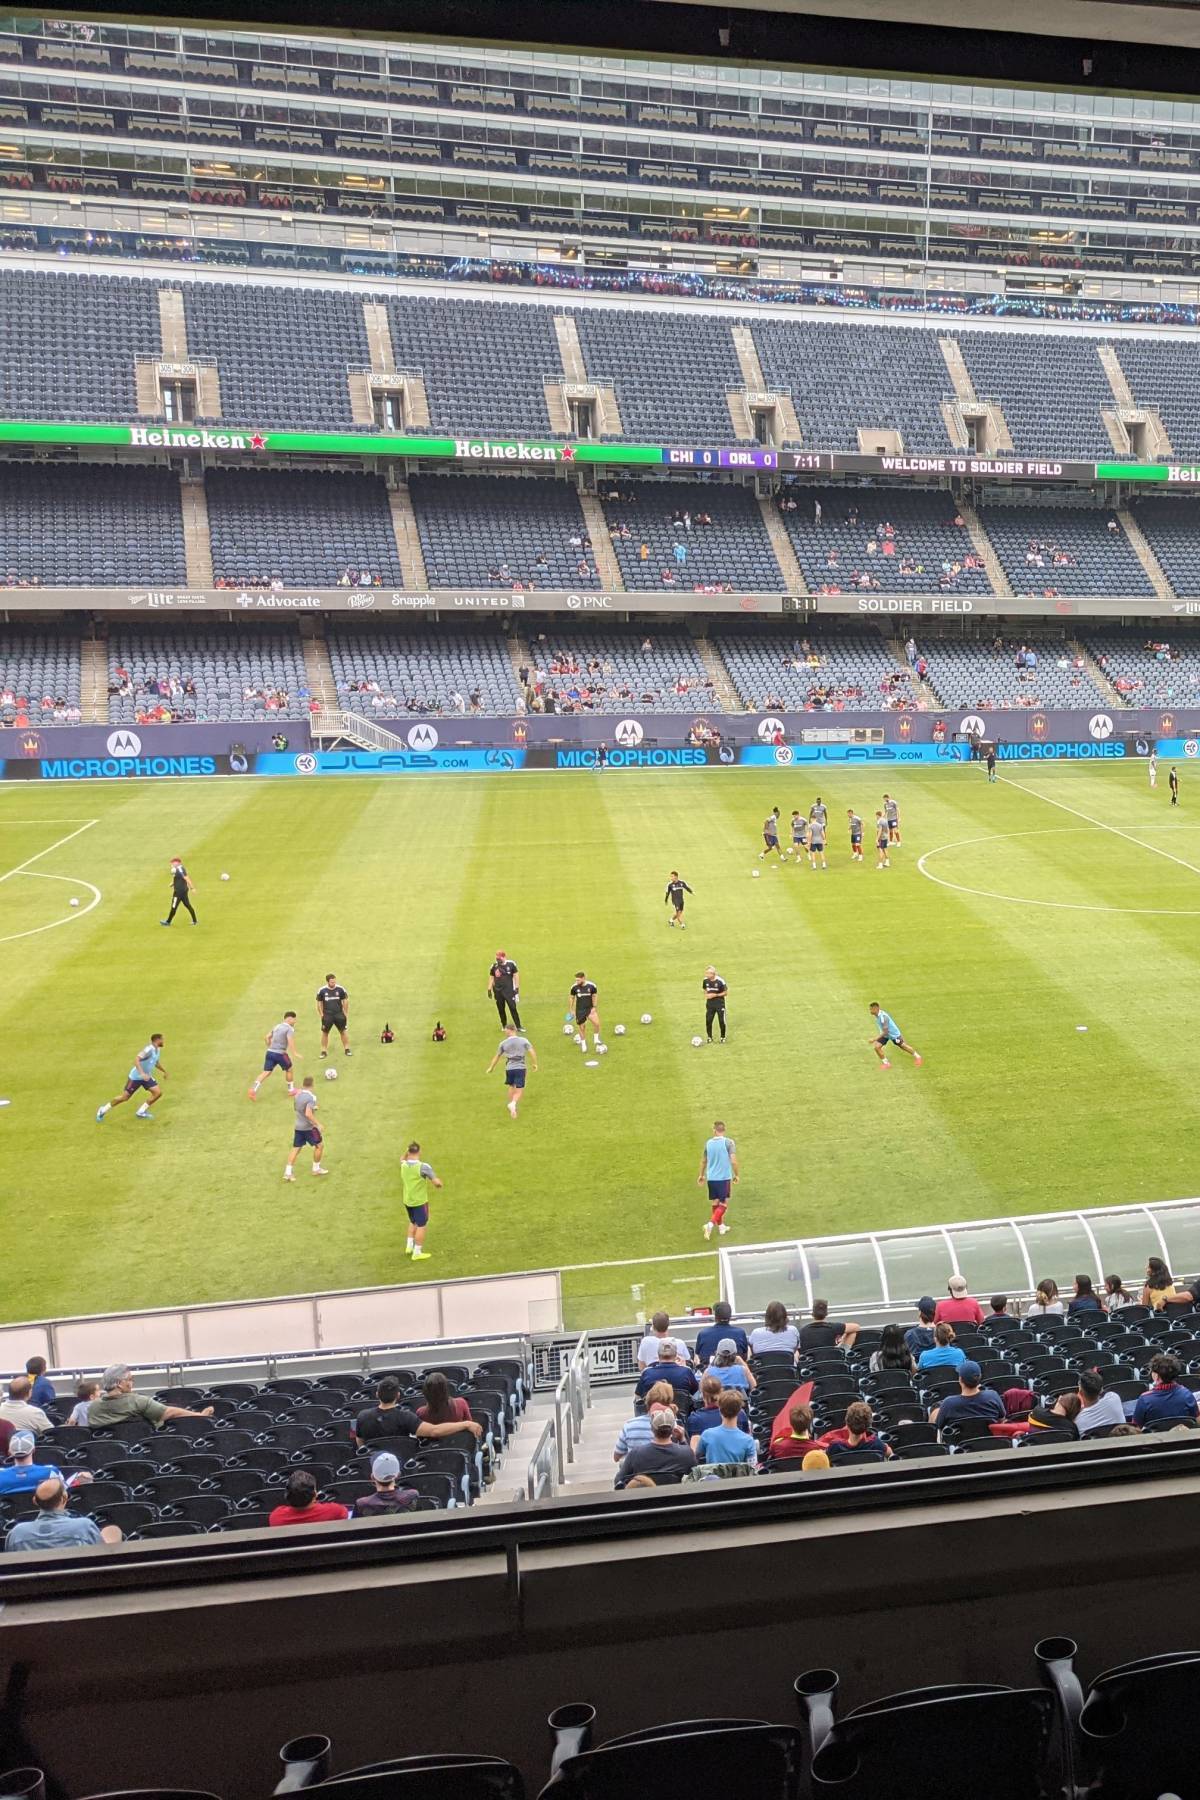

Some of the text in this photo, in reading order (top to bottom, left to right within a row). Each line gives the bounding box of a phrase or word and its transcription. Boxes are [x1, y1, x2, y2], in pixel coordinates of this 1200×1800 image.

[129, 427, 246, 449] Heineken
[454, 440, 557, 460] Heineken
[670, 450, 712, 463] CHI 0
[728, 452, 772, 466] ORL 0
[793, 454, 820, 468] 7:11
[881, 457, 1062, 476] WELCOME TO SOLDIER FIELD
[147, 592, 174, 608] Lite
[256, 595, 320, 608] Advocate
[391, 594, 436, 607] Snapple
[454, 597, 509, 606] UNITED
[583, 596, 613, 608] PNC
[859, 599, 973, 612] SOLDIER FIELD
[557, 749, 706, 767] MICOPHONES
[1000, 743, 1125, 759] MICROPHONES
[41, 757, 216, 778] MICROPHONES
[593, 1349, 616, 1365] 140
